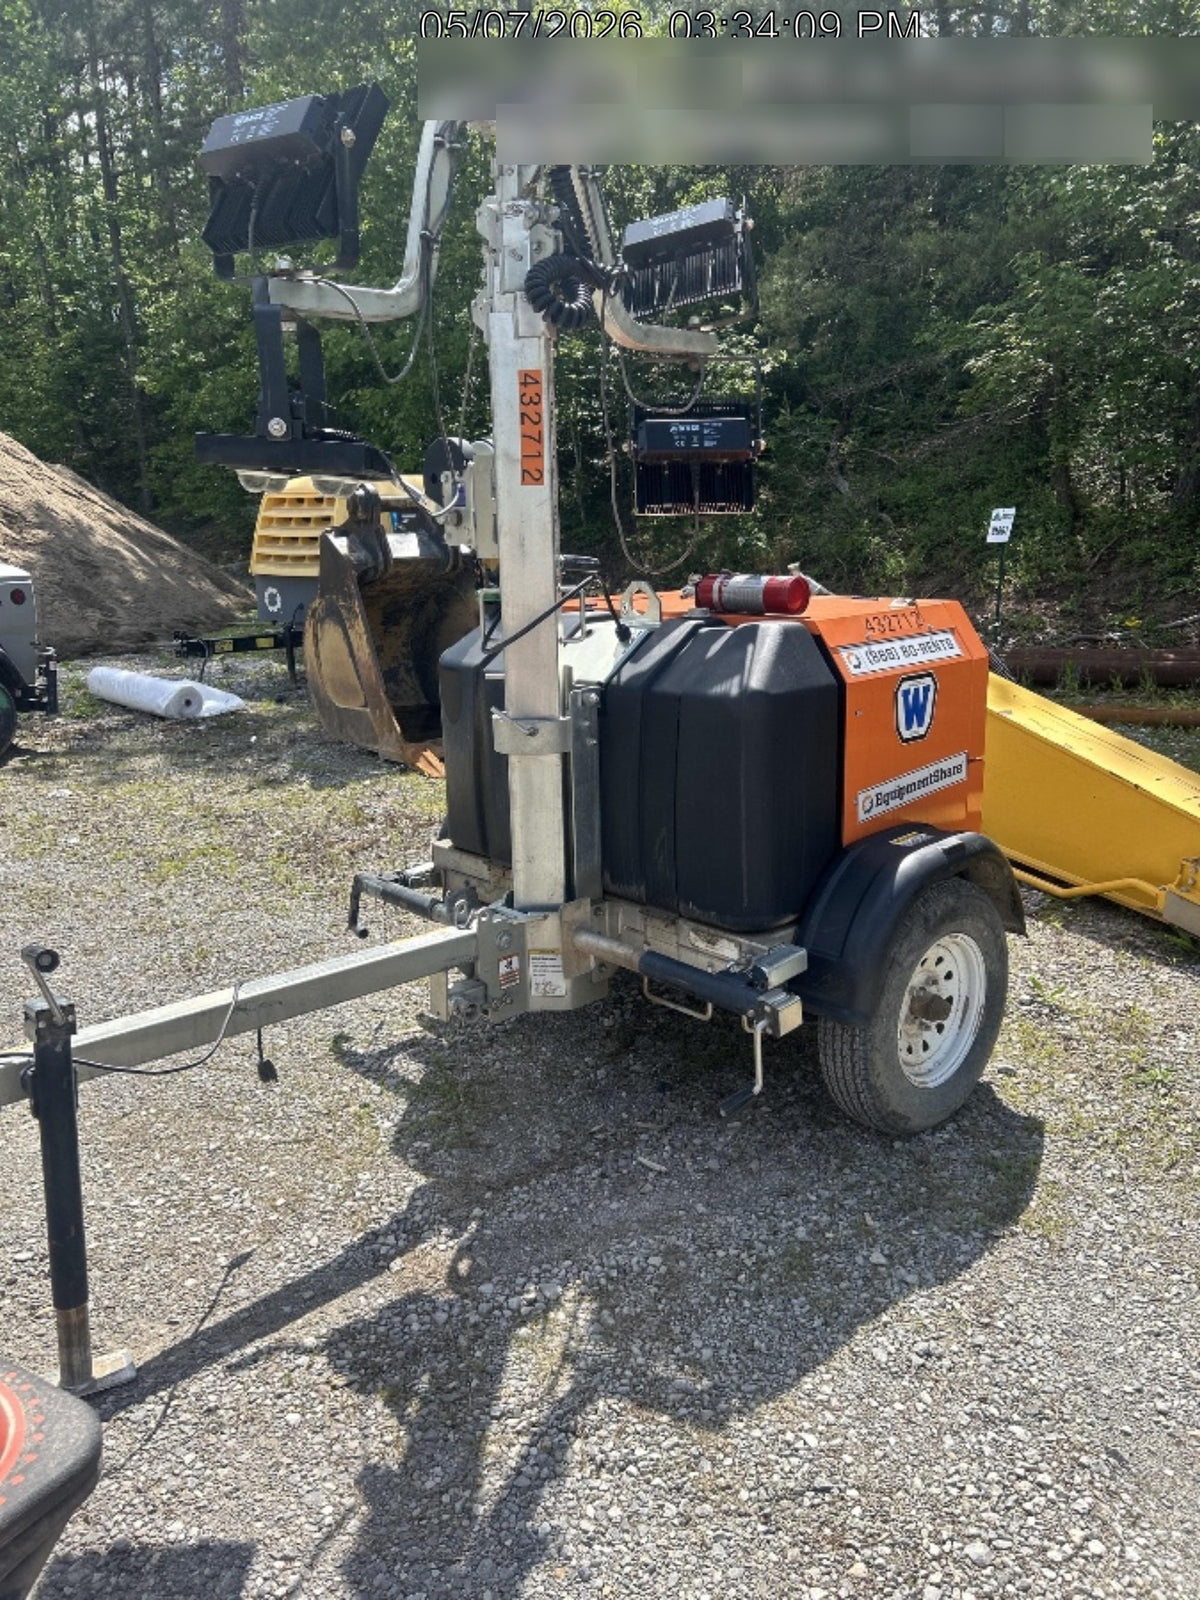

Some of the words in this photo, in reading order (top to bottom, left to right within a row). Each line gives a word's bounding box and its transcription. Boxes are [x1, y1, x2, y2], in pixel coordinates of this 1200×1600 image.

[519, 373, 543, 482] 432712
[865, 611, 924, 633] 432712
[901, 684, 931, 730] W
[875, 763, 963, 807] EquipmentShare
